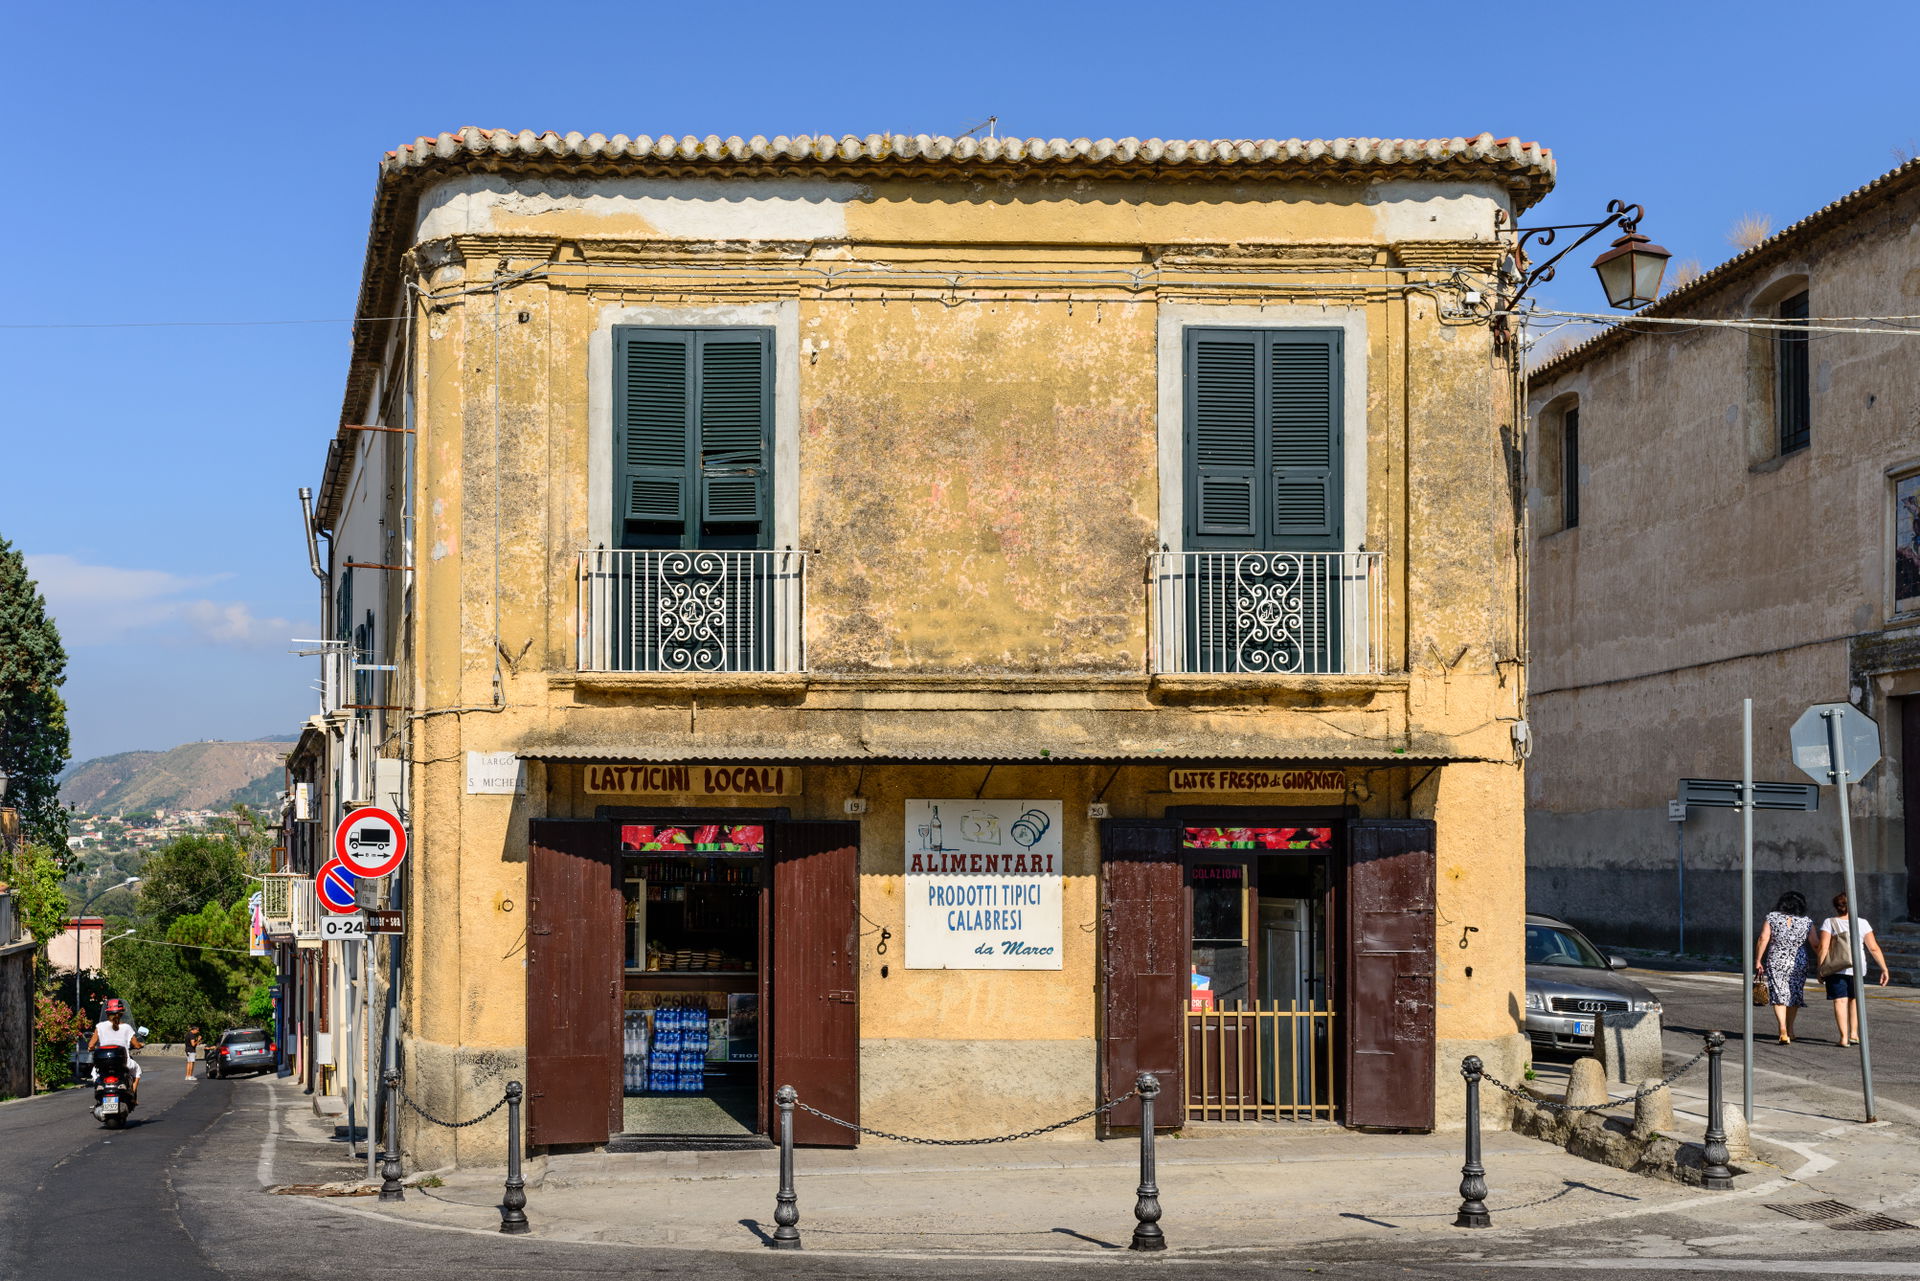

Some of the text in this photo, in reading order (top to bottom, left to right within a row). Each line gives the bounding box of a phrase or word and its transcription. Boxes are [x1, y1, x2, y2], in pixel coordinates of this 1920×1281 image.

[481, 757, 514, 766] LARGO
[483, 778, 527, 788] MICHELE
[590, 766, 784, 794] LATTICINI LOCALI
[1174, 770, 1346, 792] LATTE FRESCO di GIORNATA
[850, 801, 860, 812] 19
[911, 854, 1054, 873] ALIMENTARI
[1193, 868, 1242, 879] COLAZIONI
[929, 884, 1041, 906] PRODOTTI TIPICI
[326, 921, 364, 935] 0-24
[390, 916, 401, 927] sea
[947, 910, 1022, 931] CALABRESI
[974, 940, 1054, 956] da Marco
